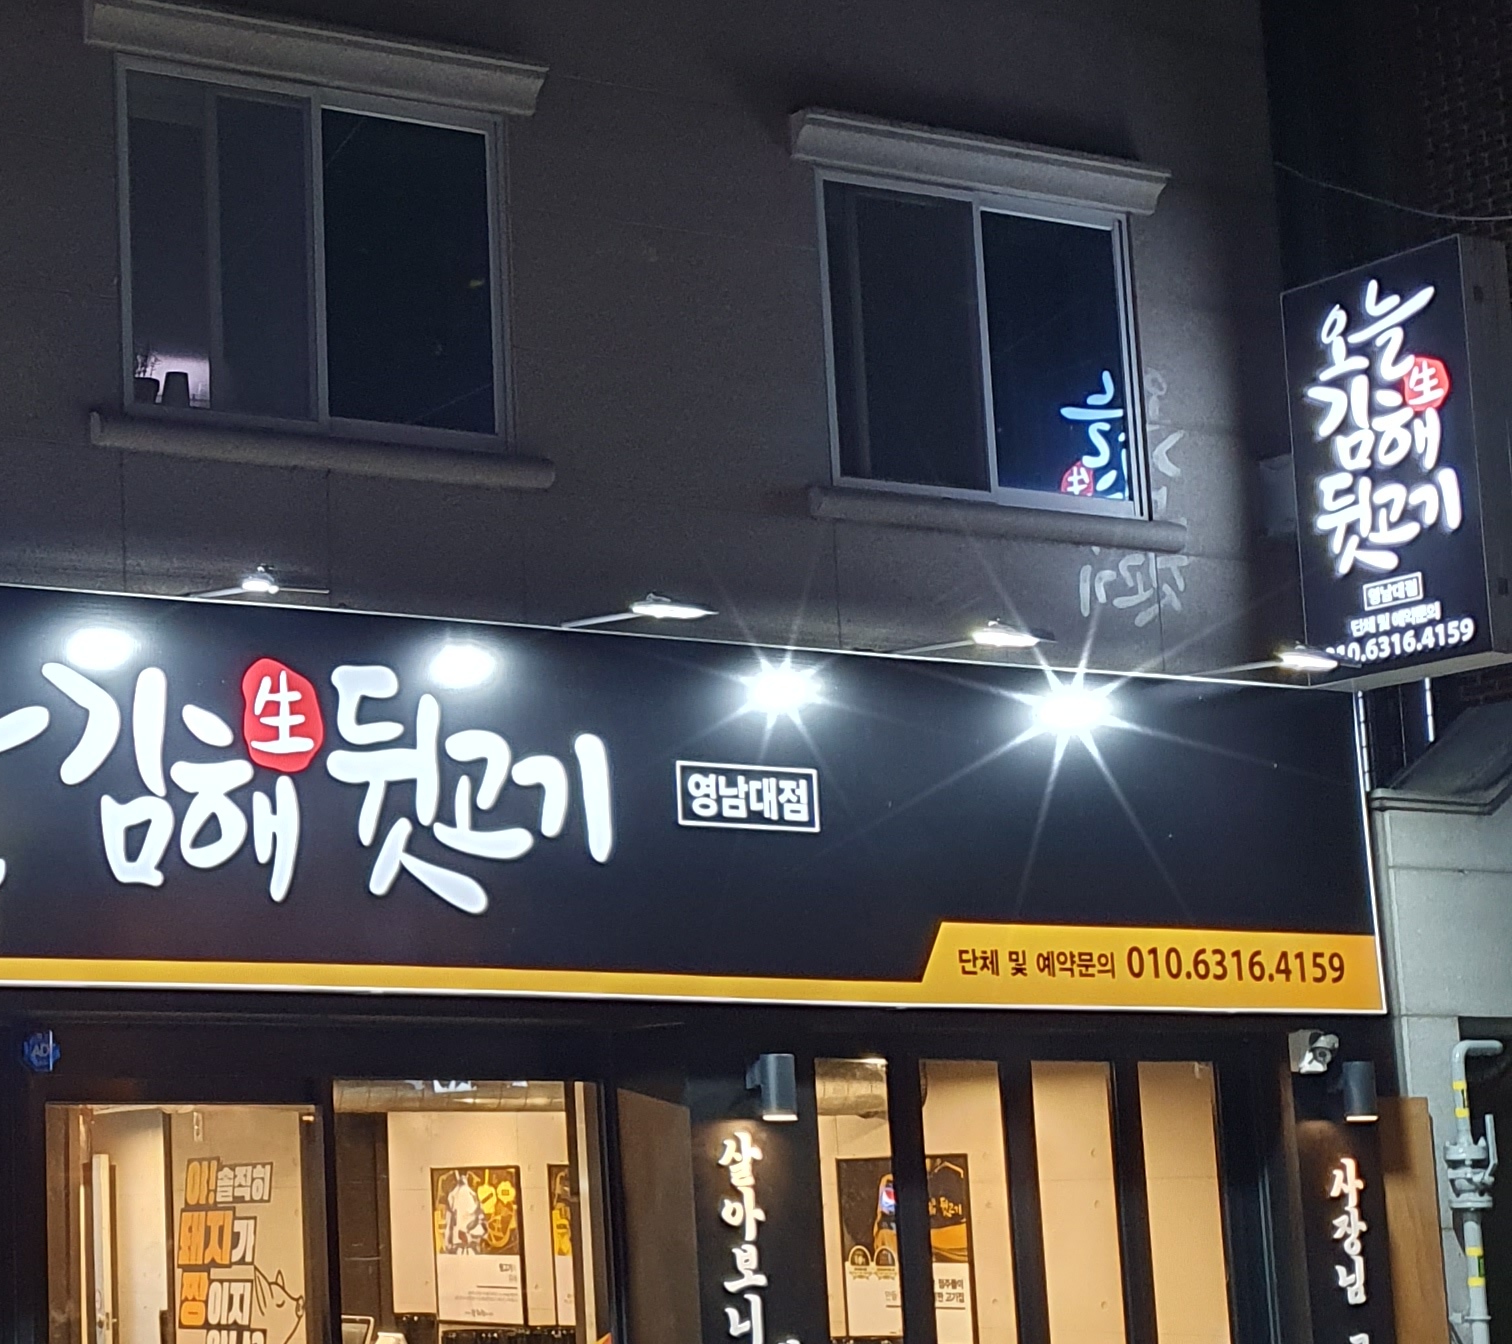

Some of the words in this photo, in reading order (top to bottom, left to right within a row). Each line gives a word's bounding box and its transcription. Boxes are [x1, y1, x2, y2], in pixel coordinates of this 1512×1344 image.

[1319, 279, 1435, 381] 오늘
[1307, 374, 1441, 471] 김해
[1317, 467, 1462, 576] 뒷고기
[687, 773, 810, 823] 영남대점
[958, 948, 999, 977] 단체
[1007, 950, 1028, 977] 및
[1036, 950, 1116, 979] 예약문의
[1126, 945, 1345, 984] 010.6316.4159
[178, 1209, 256, 1265] 돼지가
[1329, 1157, 1368, 1306] 사장님
